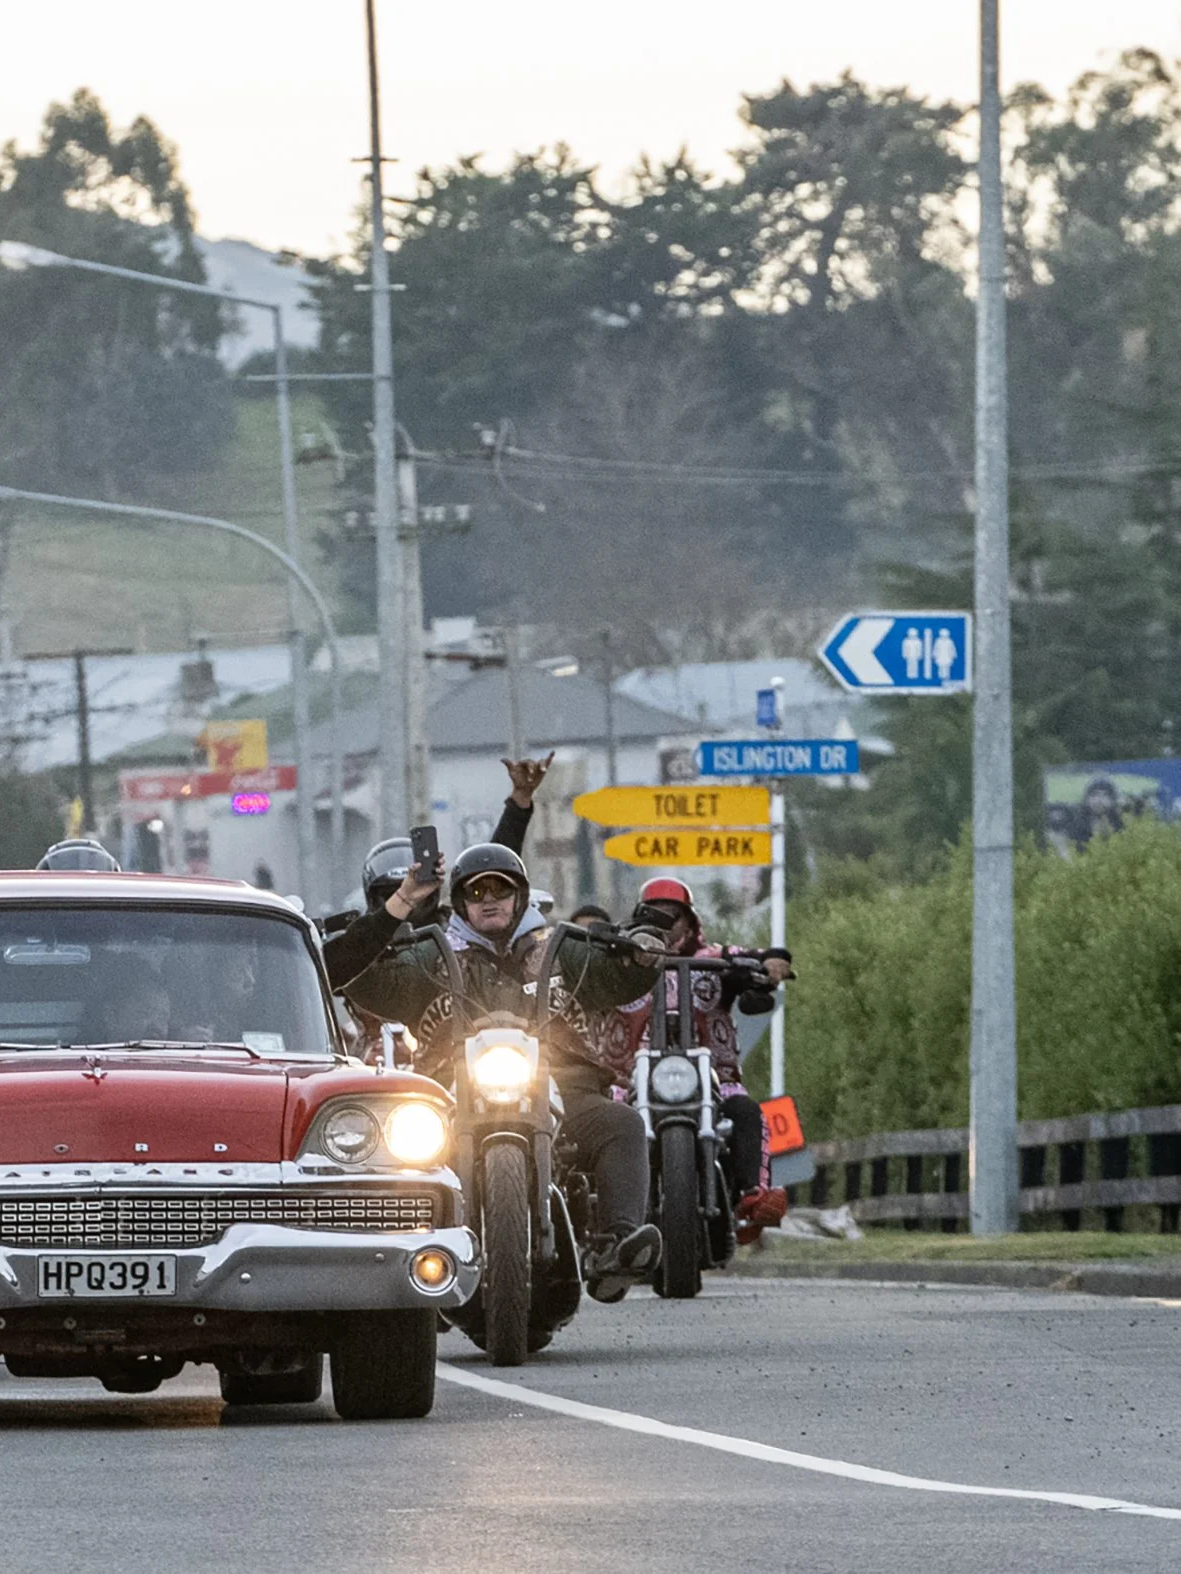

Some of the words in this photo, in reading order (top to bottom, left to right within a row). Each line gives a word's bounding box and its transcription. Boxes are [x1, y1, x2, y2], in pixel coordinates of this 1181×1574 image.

[713, 745, 812, 771] ISLINGTON
[820, 745, 847, 770] DR
[653, 792, 720, 818] TOILET
[634, 836, 679, 859] CAR
[696, 836, 755, 858] PARK
[43, 1261, 167, 1291] HPQ391
